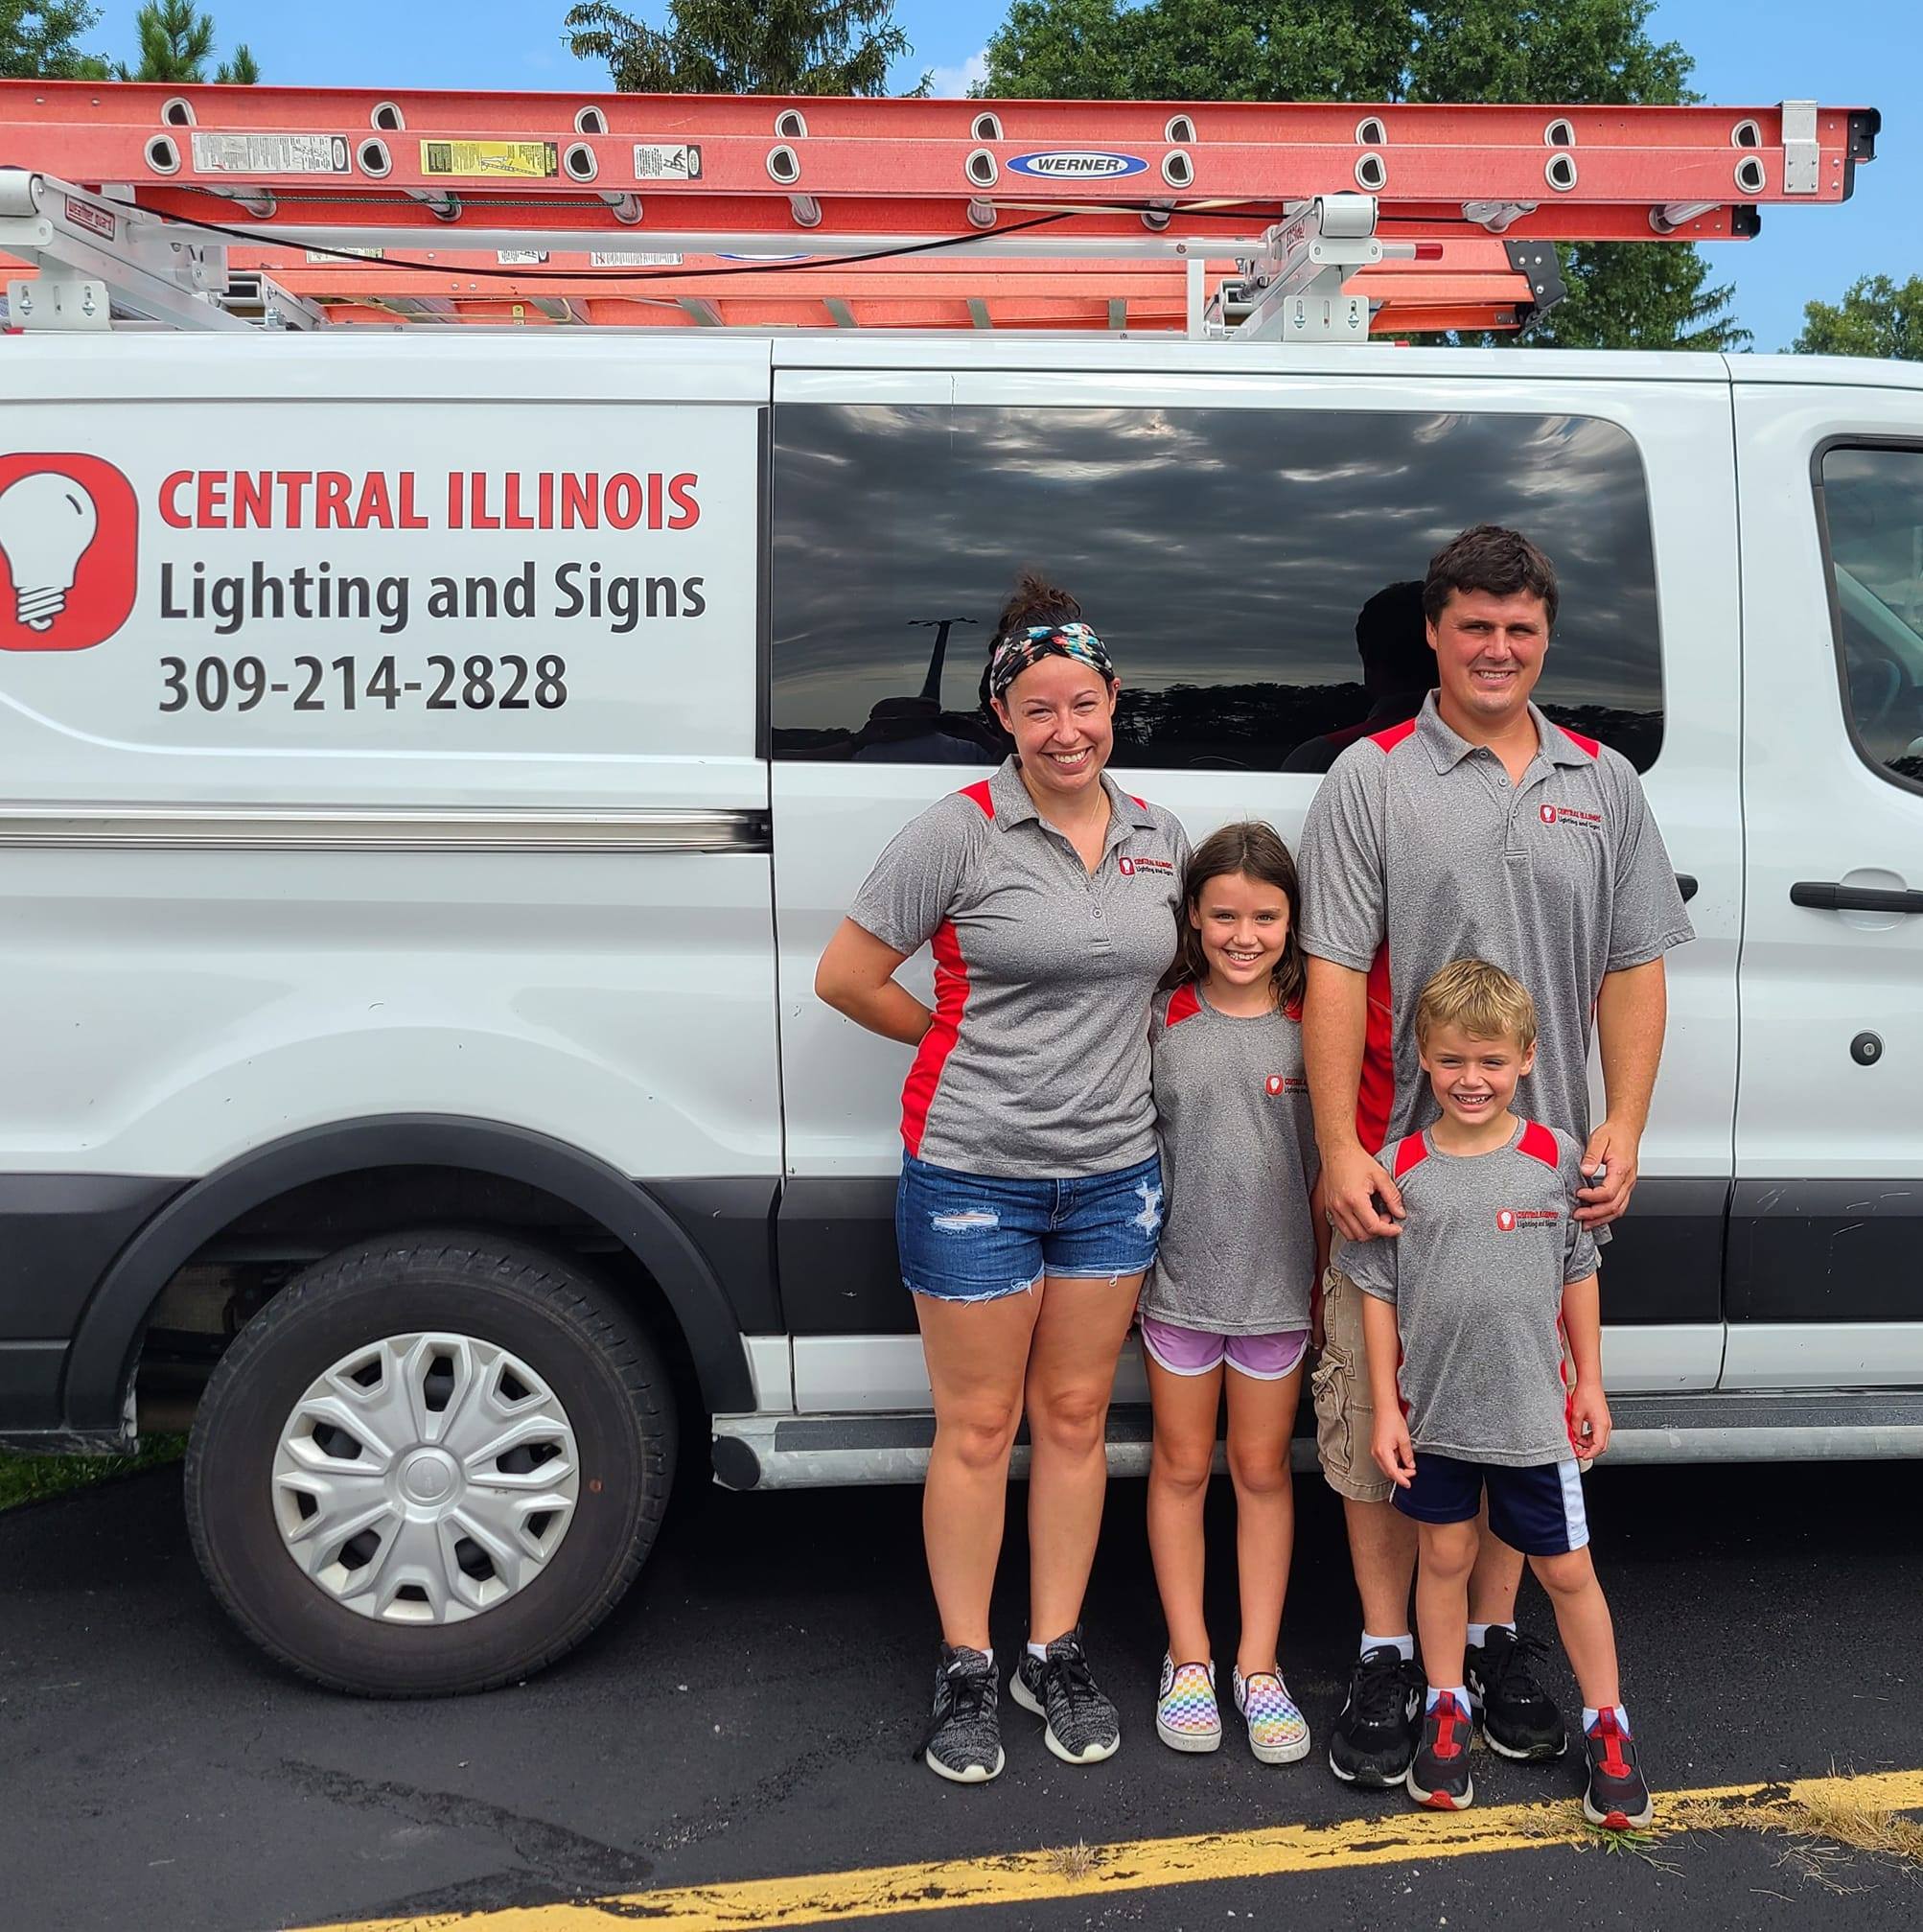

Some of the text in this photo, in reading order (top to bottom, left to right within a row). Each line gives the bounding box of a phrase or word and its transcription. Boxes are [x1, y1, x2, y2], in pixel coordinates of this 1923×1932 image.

[1037, 158, 1120, 171] WERNER
[158, 471, 701, 530] CENTRAL ILLINOIS
[161, 561, 706, 635] Lighting and Signs
[158, 655, 568, 712] 309-214-2828
